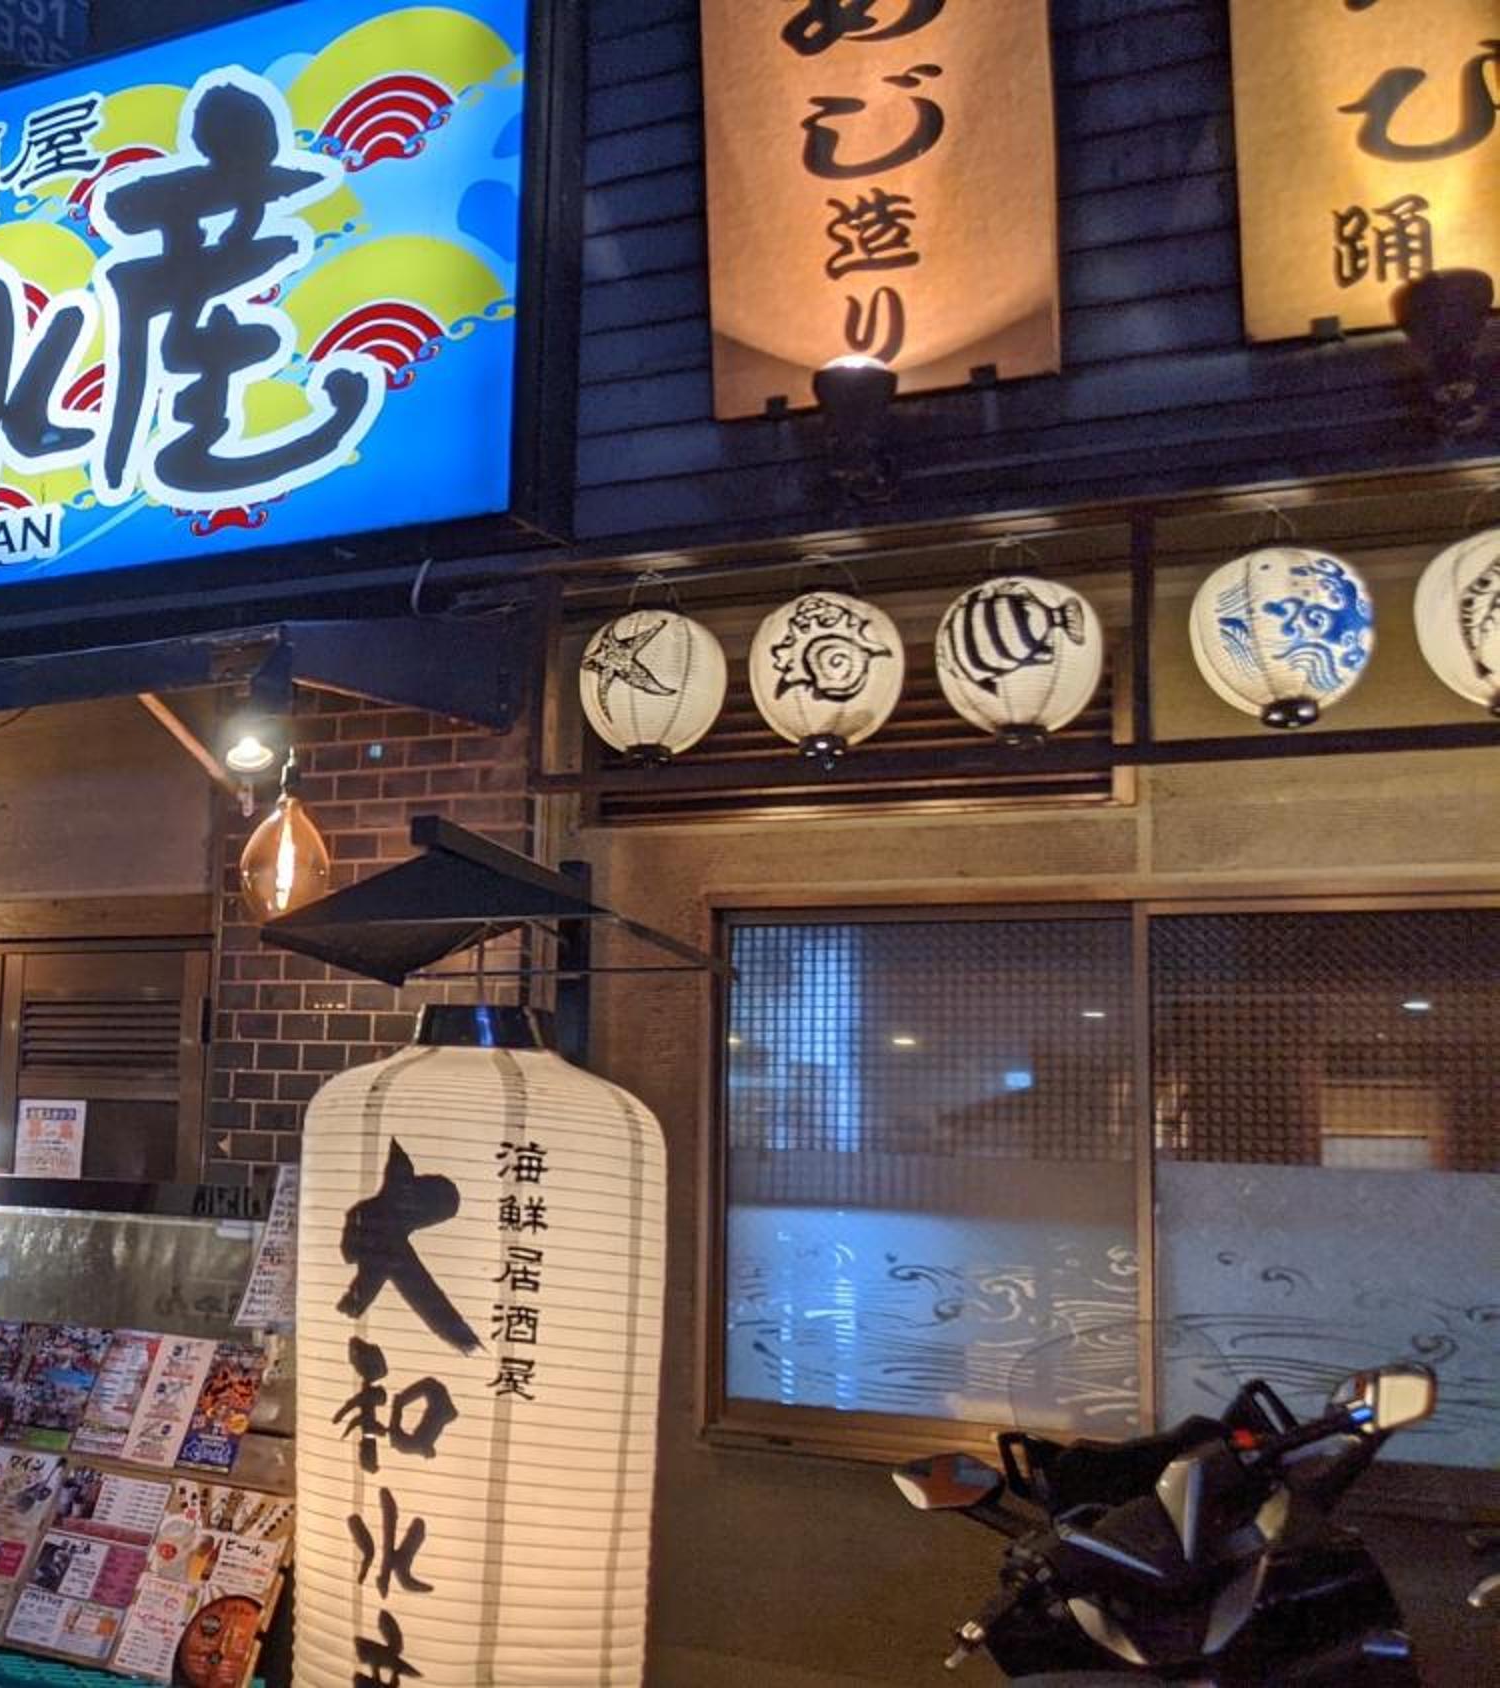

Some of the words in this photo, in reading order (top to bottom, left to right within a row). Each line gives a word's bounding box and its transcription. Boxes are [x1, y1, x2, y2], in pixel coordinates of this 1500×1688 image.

[486, 1140, 549, 1402] 海鮮居酒屋
